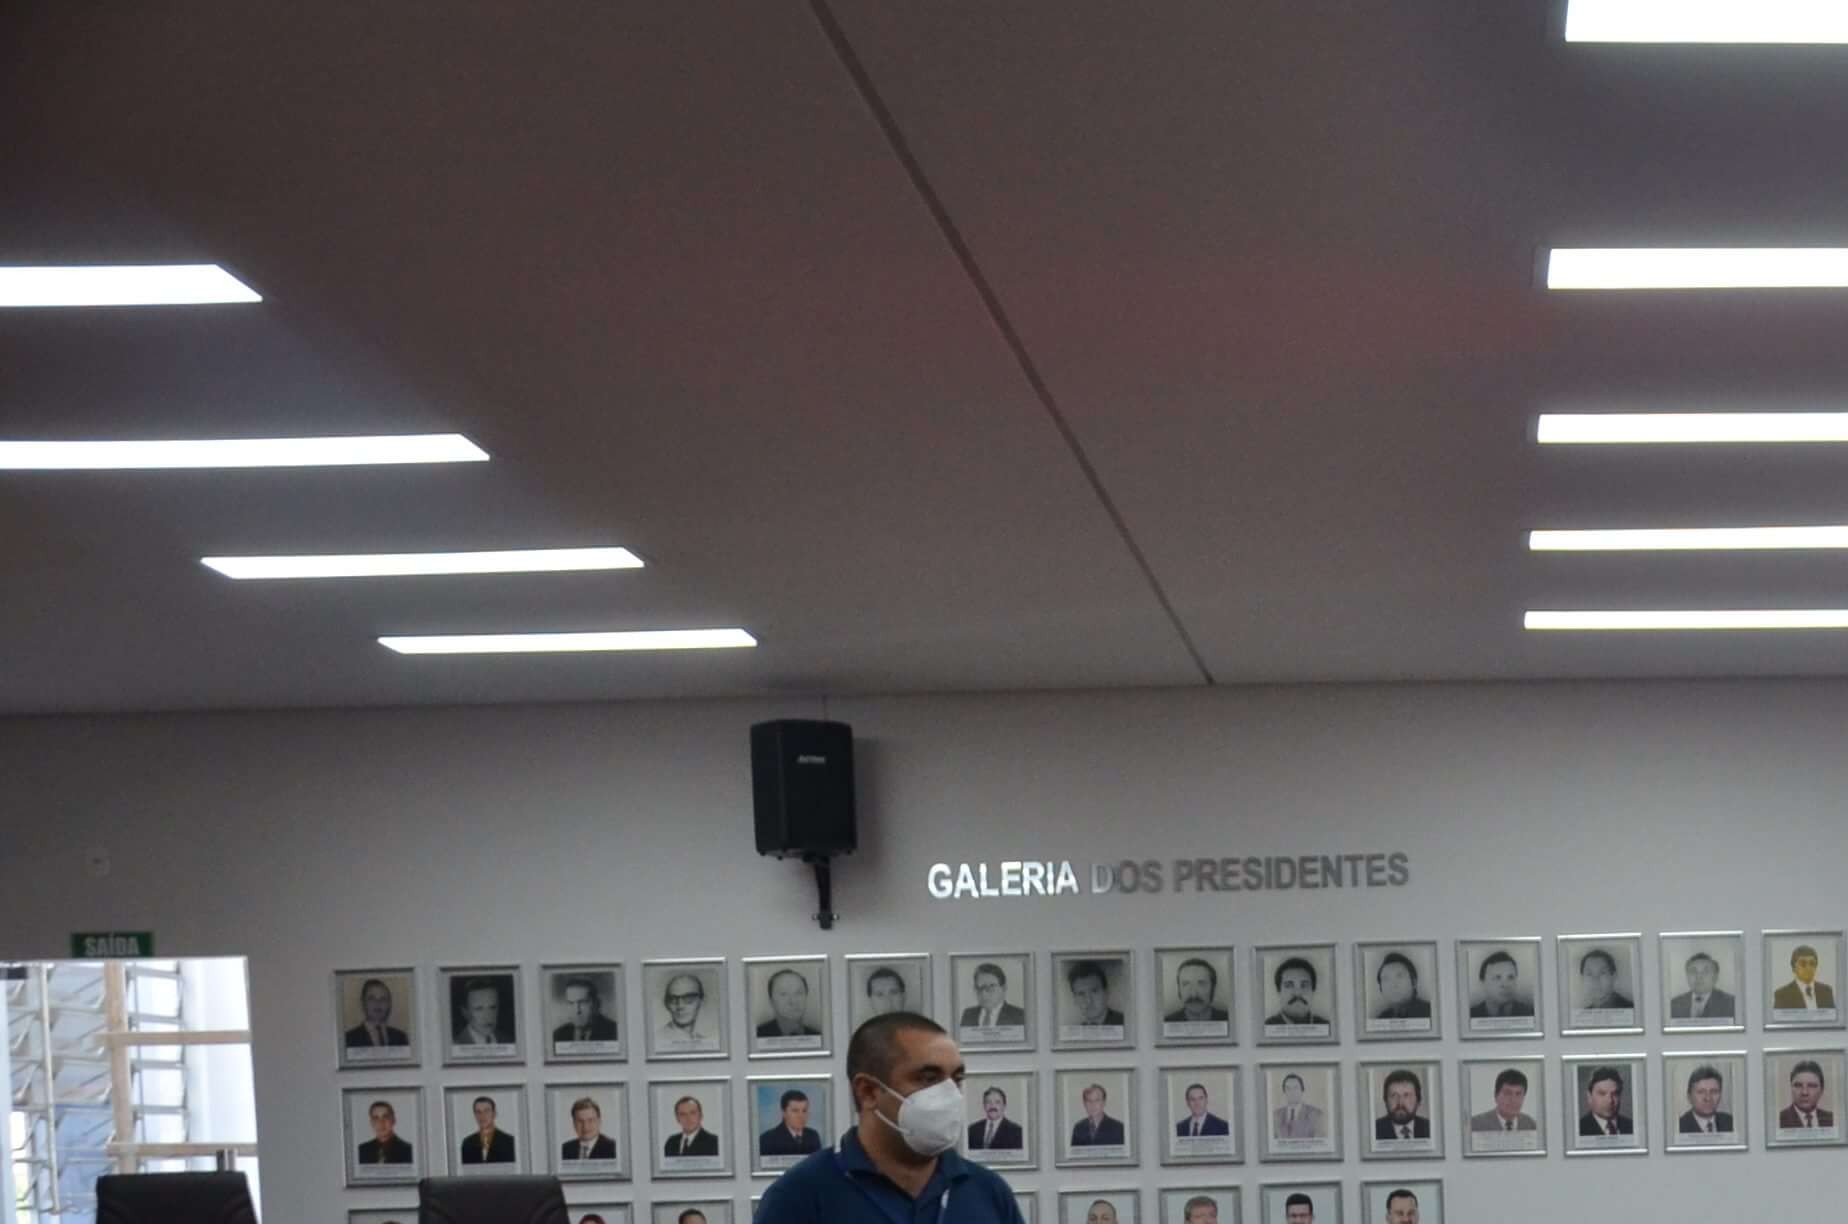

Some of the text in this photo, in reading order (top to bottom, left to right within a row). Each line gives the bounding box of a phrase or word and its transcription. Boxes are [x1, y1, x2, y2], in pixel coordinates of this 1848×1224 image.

[927, 852, 1410, 899] GALERIA DOS PRESIDENTES
[85, 932, 140, 956] SAÍDA
